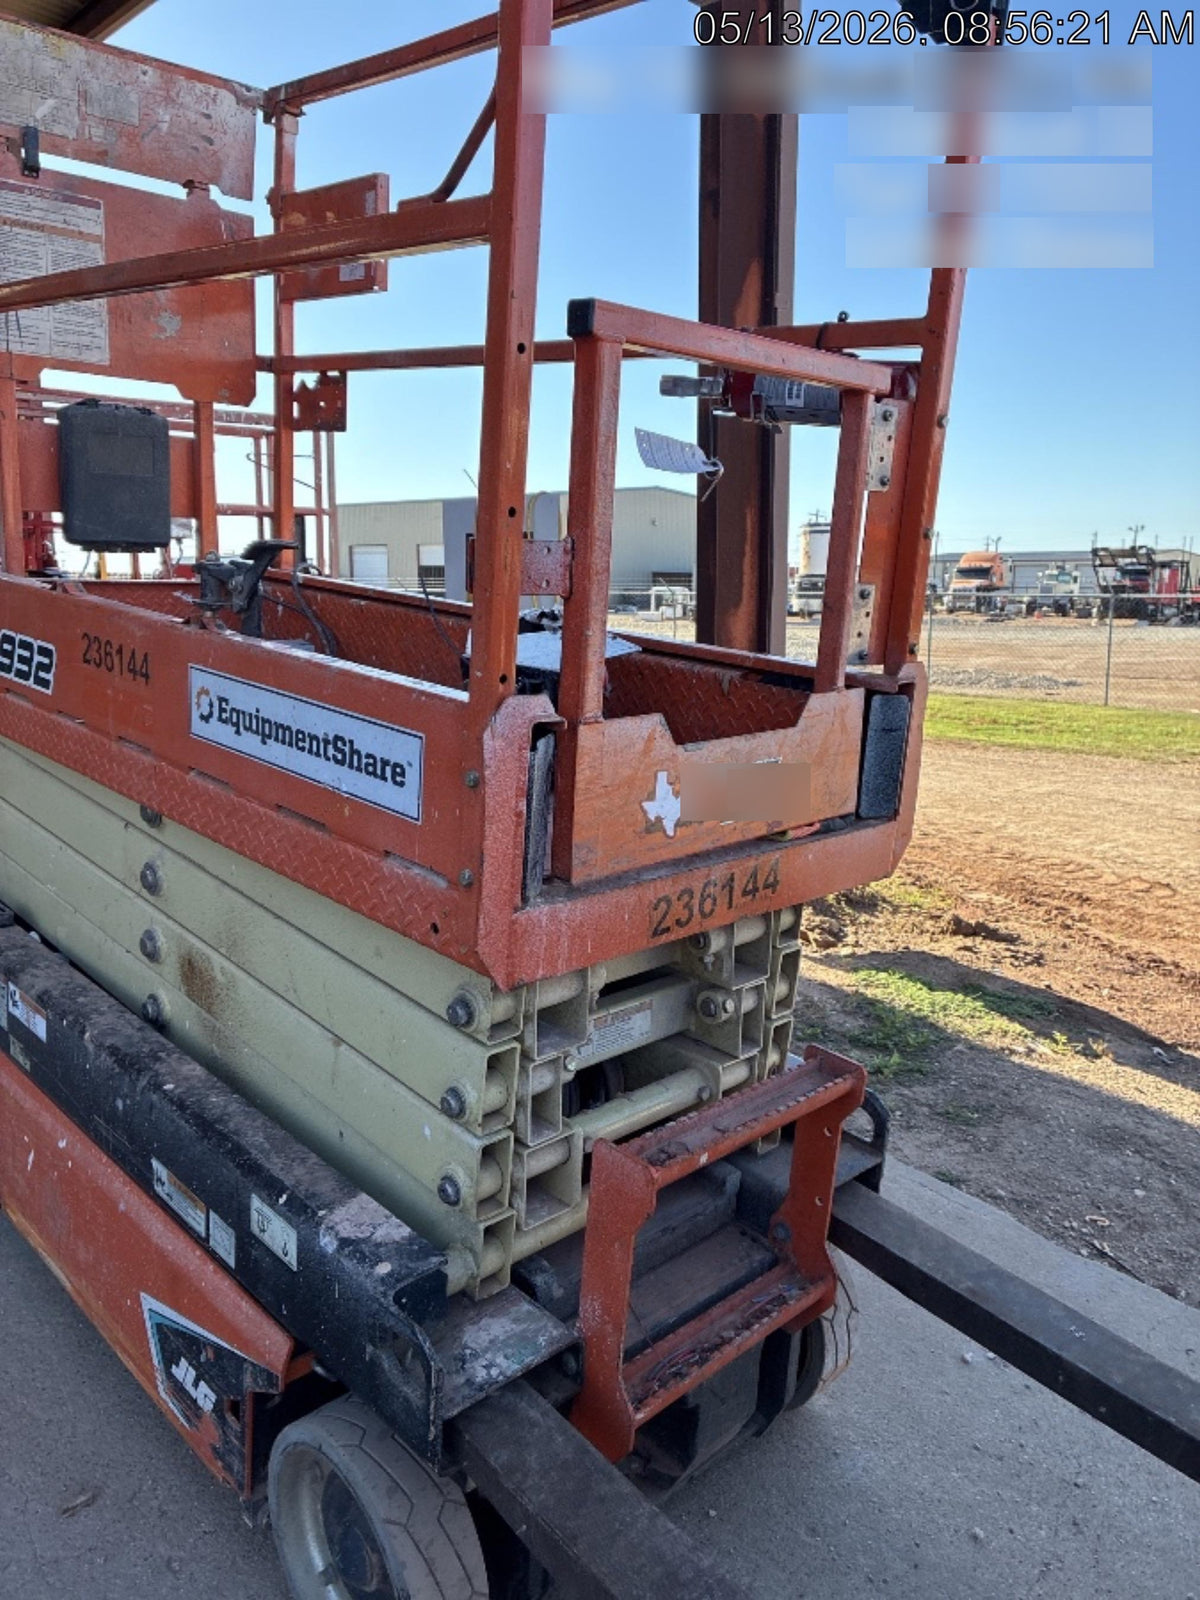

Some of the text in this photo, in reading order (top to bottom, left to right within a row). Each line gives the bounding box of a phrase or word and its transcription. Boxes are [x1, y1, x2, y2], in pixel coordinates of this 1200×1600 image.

[82, 633, 150, 686] 236144
[217, 695, 406, 788] EquipmentShare
[651, 857, 781, 939] 236144
